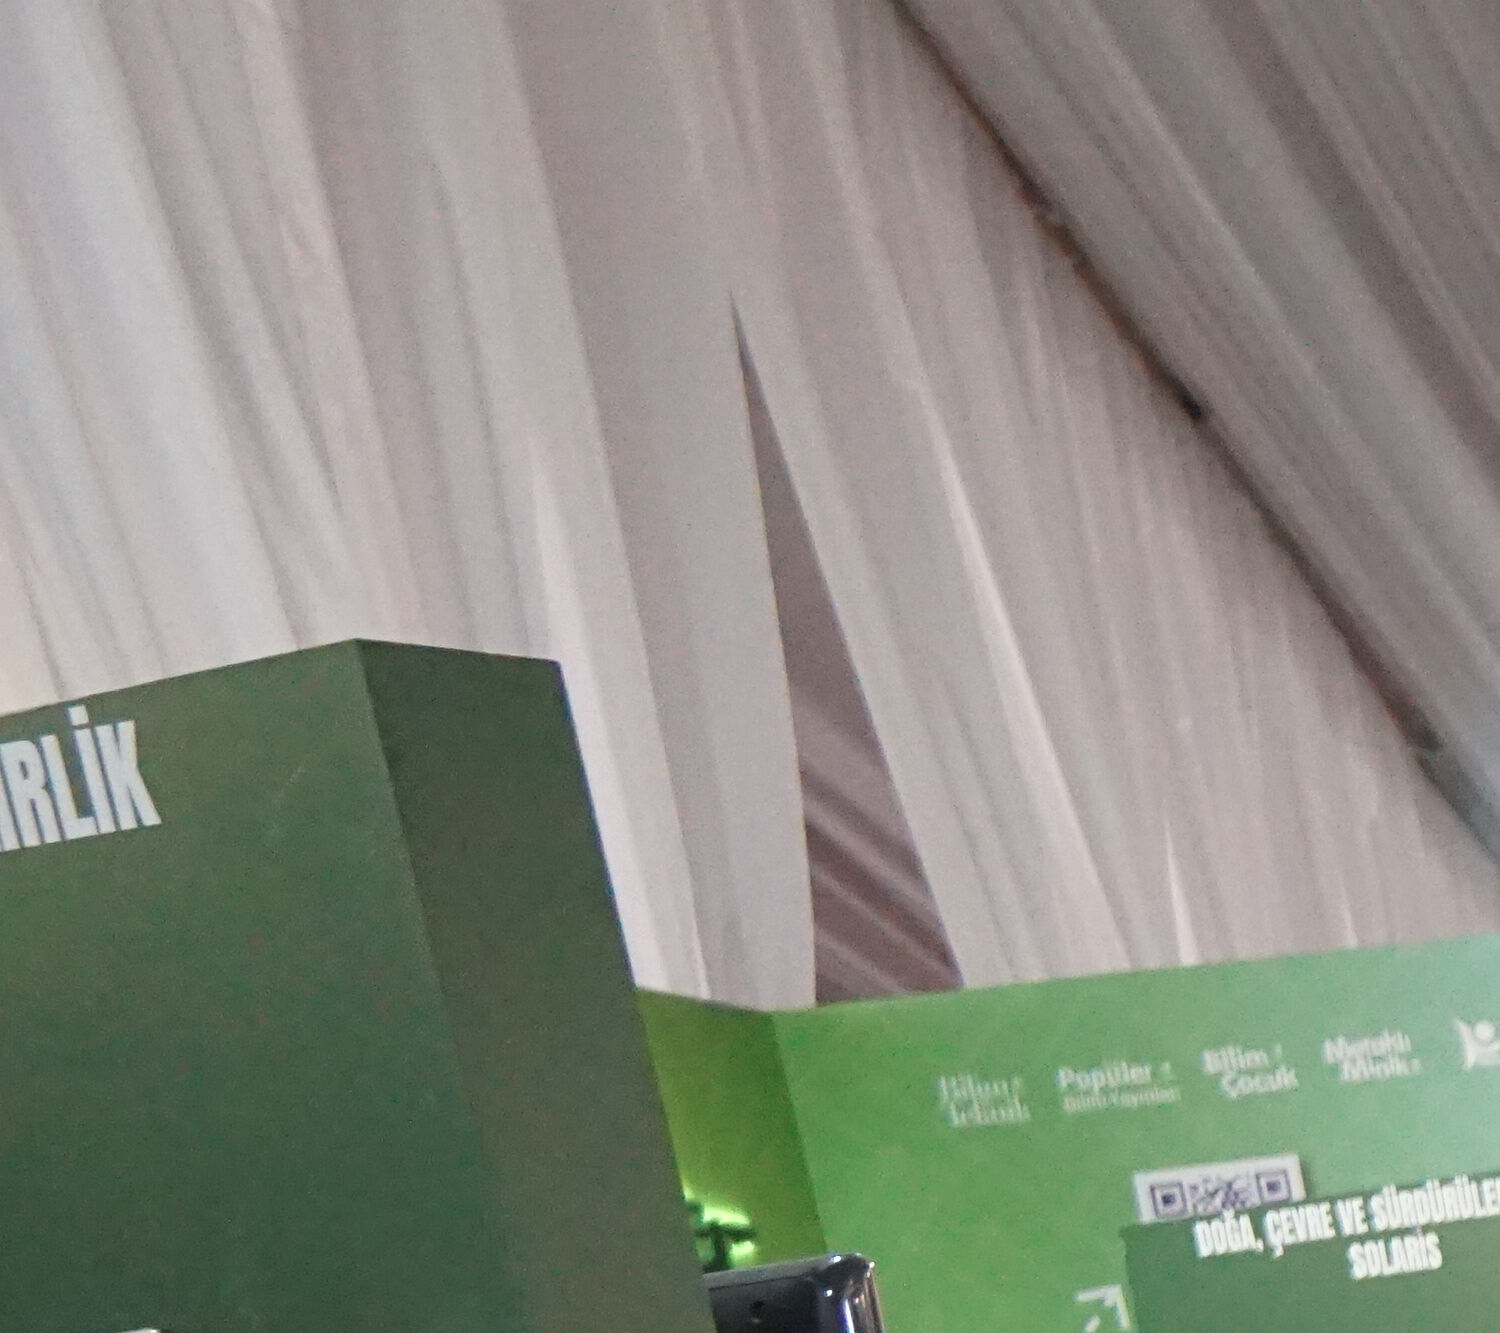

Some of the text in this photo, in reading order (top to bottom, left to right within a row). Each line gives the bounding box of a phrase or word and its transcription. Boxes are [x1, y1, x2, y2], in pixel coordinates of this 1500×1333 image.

[1193, 1208, 1264, 1258] DOĞA,
[1264, 1201, 1335, 1258] ÇEVRE
[1336, 1195, 1369, 1237] VE
[1347, 1226, 1443, 1281] SOLARİS
